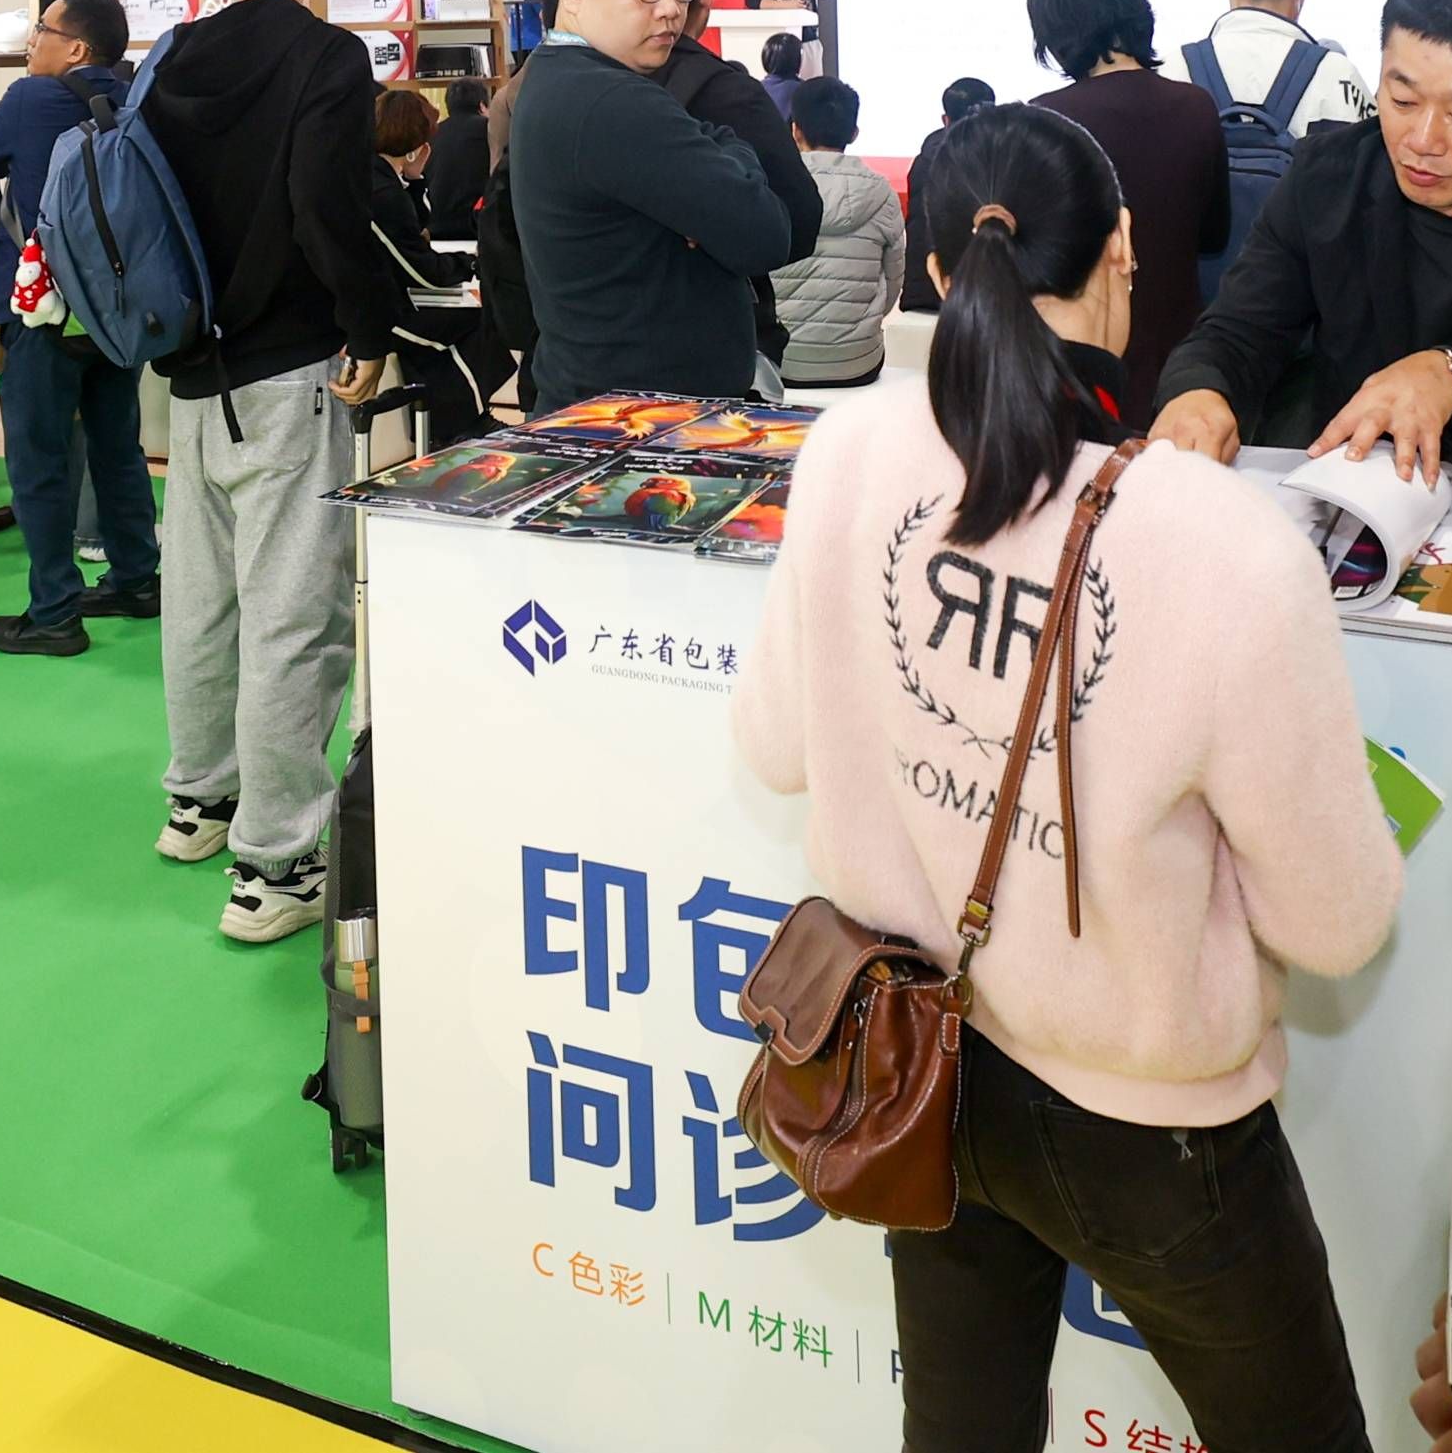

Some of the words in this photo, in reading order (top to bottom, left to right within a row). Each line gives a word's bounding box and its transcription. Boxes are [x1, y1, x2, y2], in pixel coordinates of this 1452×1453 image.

[588, 624, 739, 675] 广东省包装
[591, 663, 659, 683] GUANGDONG
[661, 675, 724, 694] PACKAGING
[532, 1242, 555, 1278] C
[568, 1250, 647, 1307] 色彩
[698, 1289, 732, 1333] M
[748, 1303, 834, 1368] 材料
[1084, 1409, 1108, 1447] S
